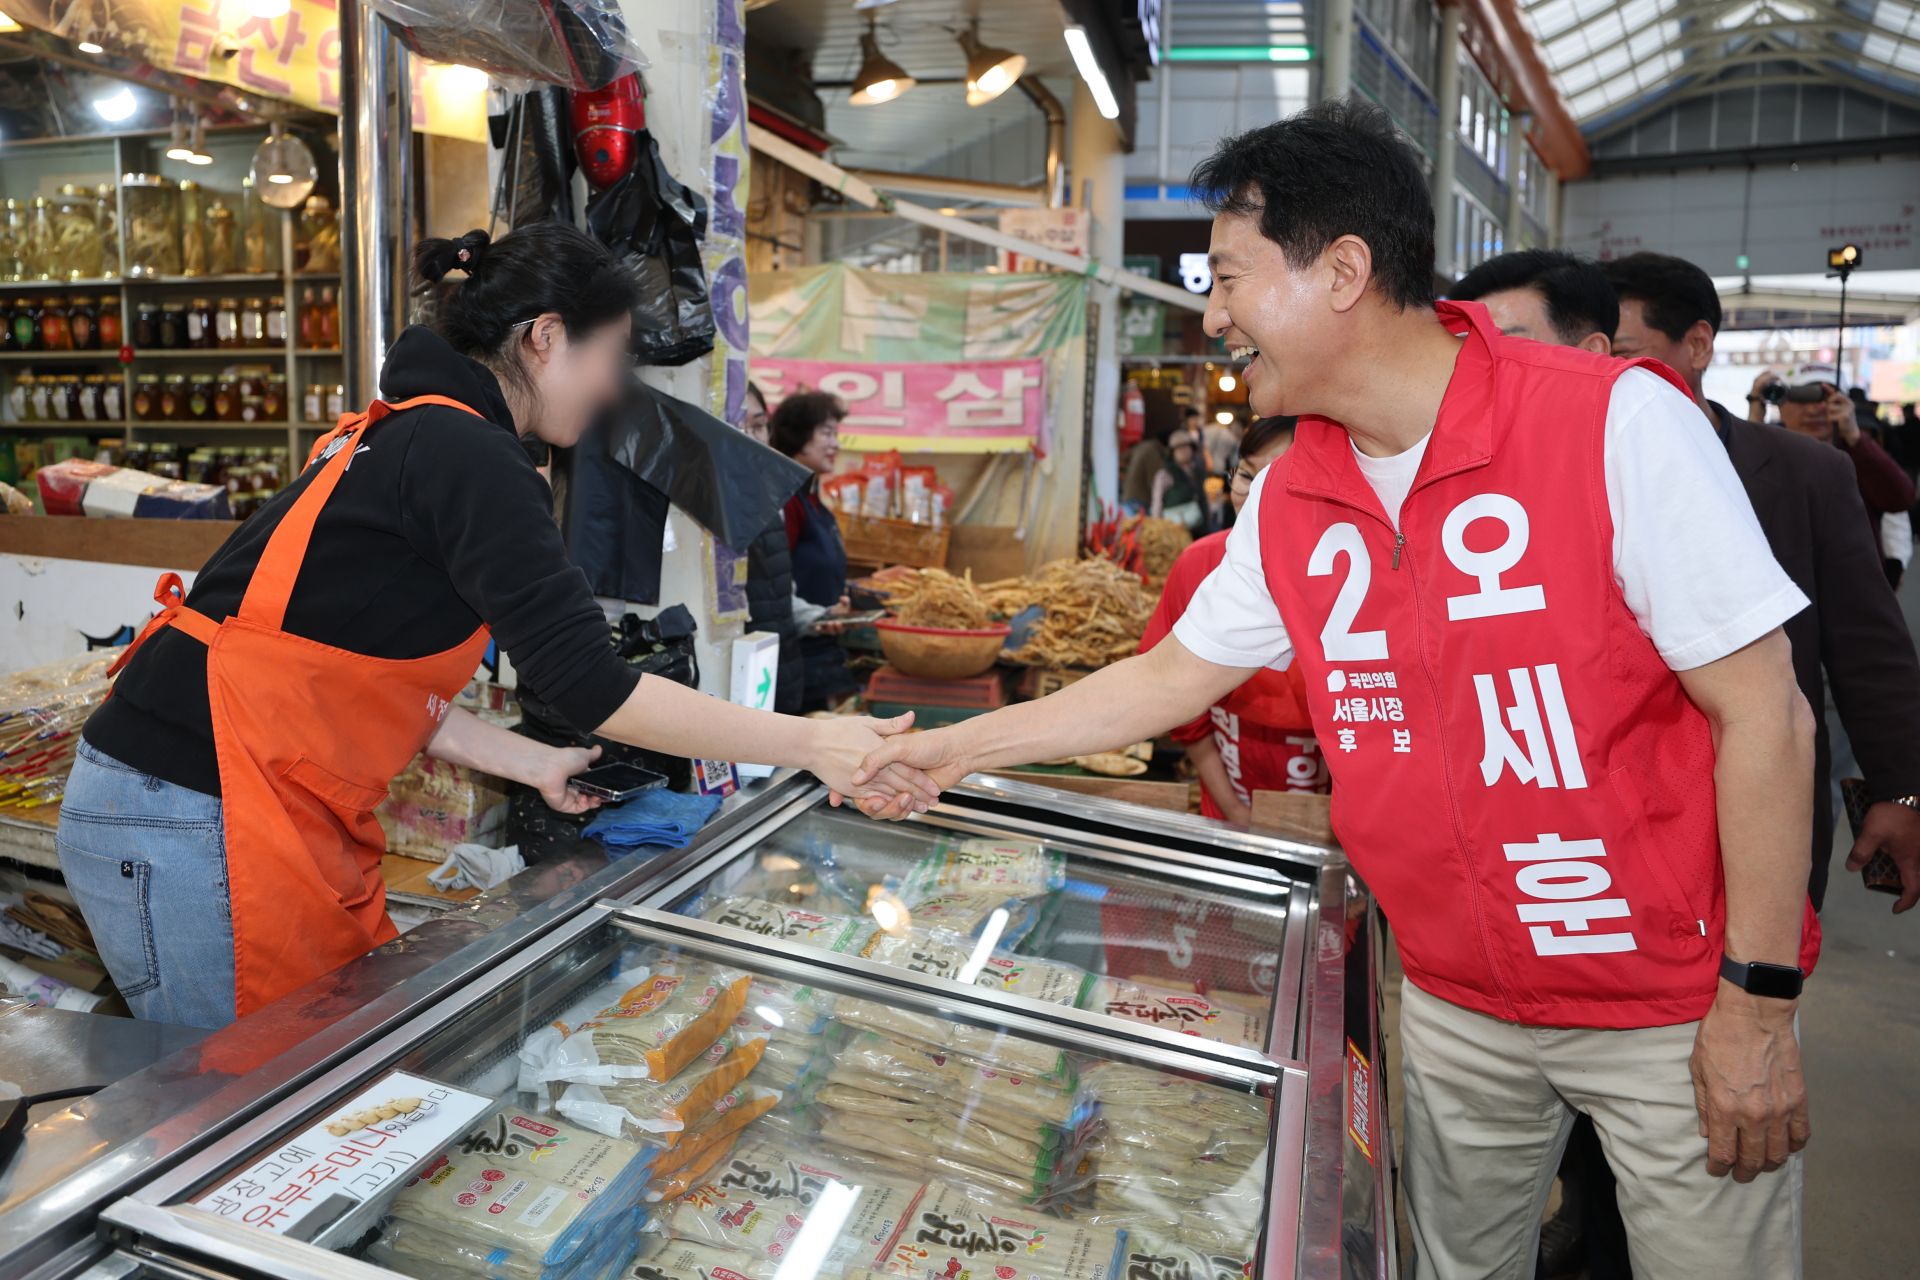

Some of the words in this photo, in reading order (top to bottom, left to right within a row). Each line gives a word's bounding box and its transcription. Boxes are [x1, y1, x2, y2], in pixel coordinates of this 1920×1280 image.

[750, 366, 1042, 428] 인삼
[1307, 521, 1390, 662] 2
[1332, 697, 1405, 723] 서울시장
[1348, 671, 1398, 690] 국민의힘
[1441, 493, 1638, 957] 오세훈
[211, 1144, 317, 1216] 냉장고에
[242, 1127, 397, 1228] 유부주머니
[384, 1088, 453, 1135] 있습니다
